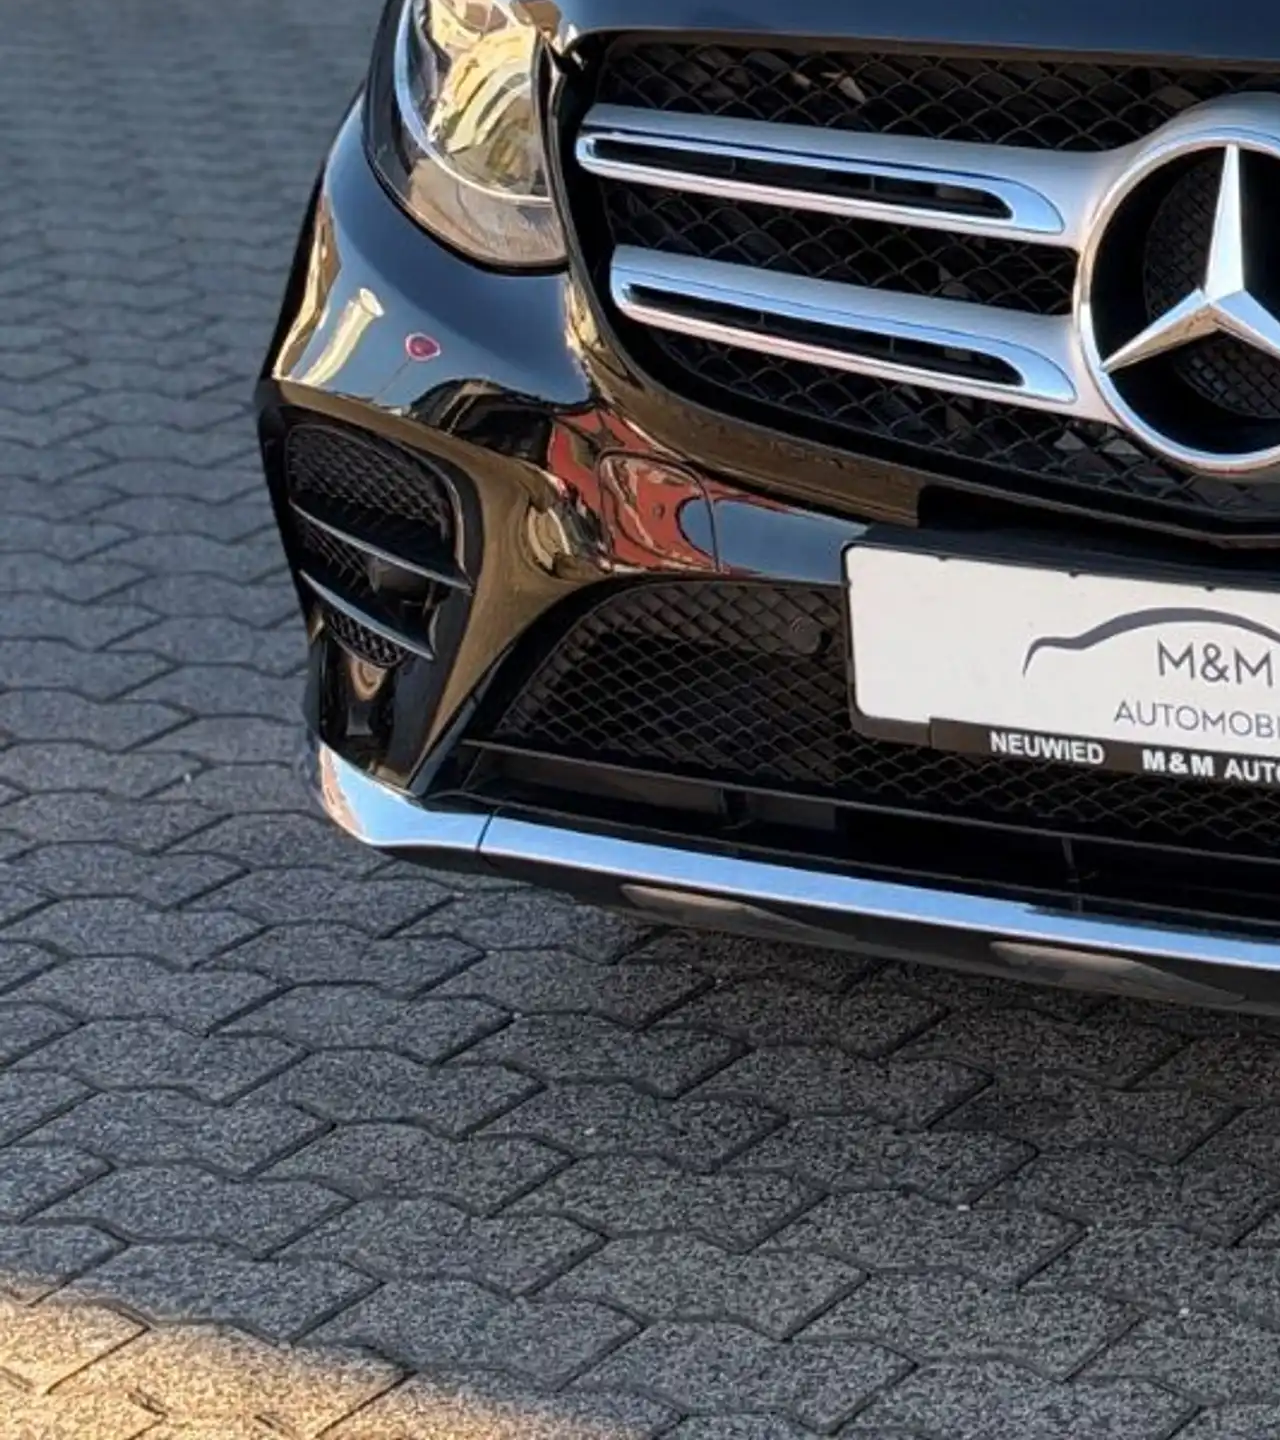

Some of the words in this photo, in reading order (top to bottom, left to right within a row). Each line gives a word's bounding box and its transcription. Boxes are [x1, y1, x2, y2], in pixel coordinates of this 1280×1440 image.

[1156, 639, 1274, 689] M&M
[989, 730, 1105, 765] NEUWIED
[1141, 748, 1215, 778] M&M
